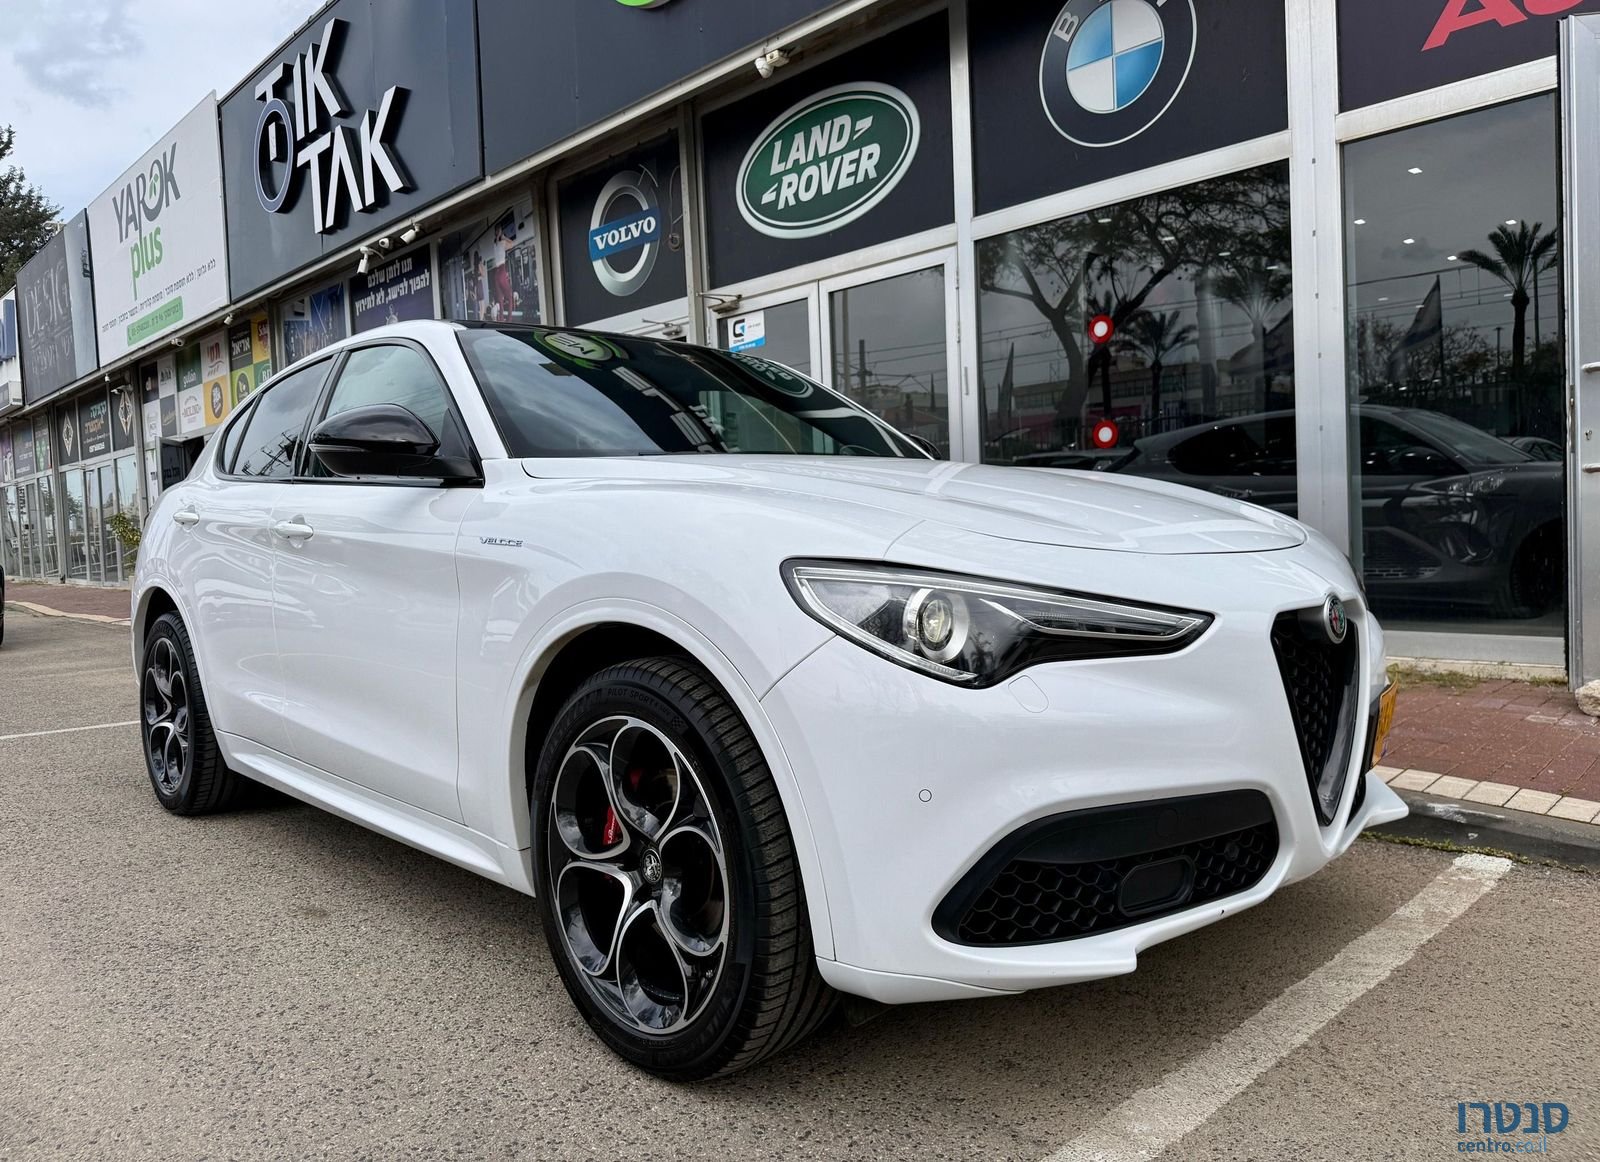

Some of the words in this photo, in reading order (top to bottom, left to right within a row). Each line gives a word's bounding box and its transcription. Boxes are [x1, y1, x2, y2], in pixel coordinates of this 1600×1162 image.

[1421, 0, 1583, 52] A
[254, 17, 350, 161] TIK
[296, 85, 411, 235] TAK
[769, 114, 852, 176] LAND
[777, 143, 881, 210] ROVER
[112, 142, 181, 244] YAROK
[593, 216, 656, 250] VOLVO
[130, 226, 163, 301] plus
[367, 268, 385, 288] שלכם
[385, 259, 400, 283] לזמן
[401, 257, 412, 274] תנו
[376, 287, 385, 306] לא
[409, 268, 430, 295] להפוך
[355, 291, 375, 317] לתירוץ
[231, 336, 251, 356] אריאל
[607, 688, 628, 697] PILOT
